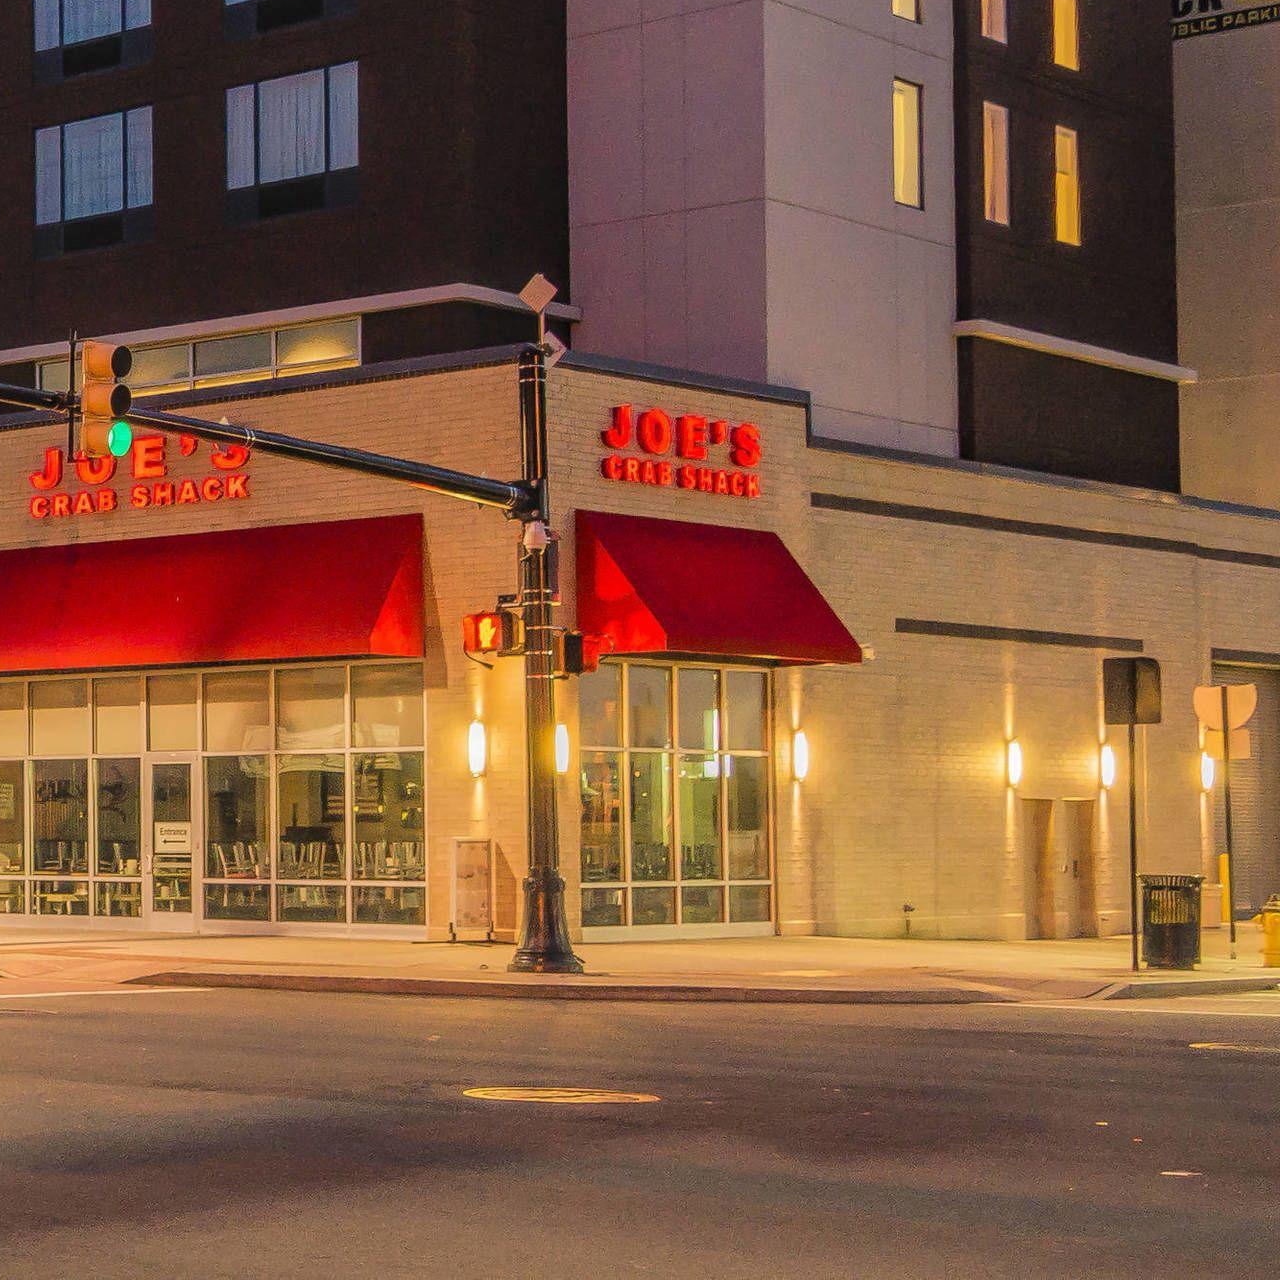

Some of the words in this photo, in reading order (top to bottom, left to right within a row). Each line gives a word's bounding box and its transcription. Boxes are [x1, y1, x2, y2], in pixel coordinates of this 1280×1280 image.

[601, 402, 762, 468] JOE'S
[30, 487, 117, 518] CRAB
[131, 474, 250, 508] SHACK
[601, 455, 673, 487] CRAB
[676, 464, 761, 498] SHACK
